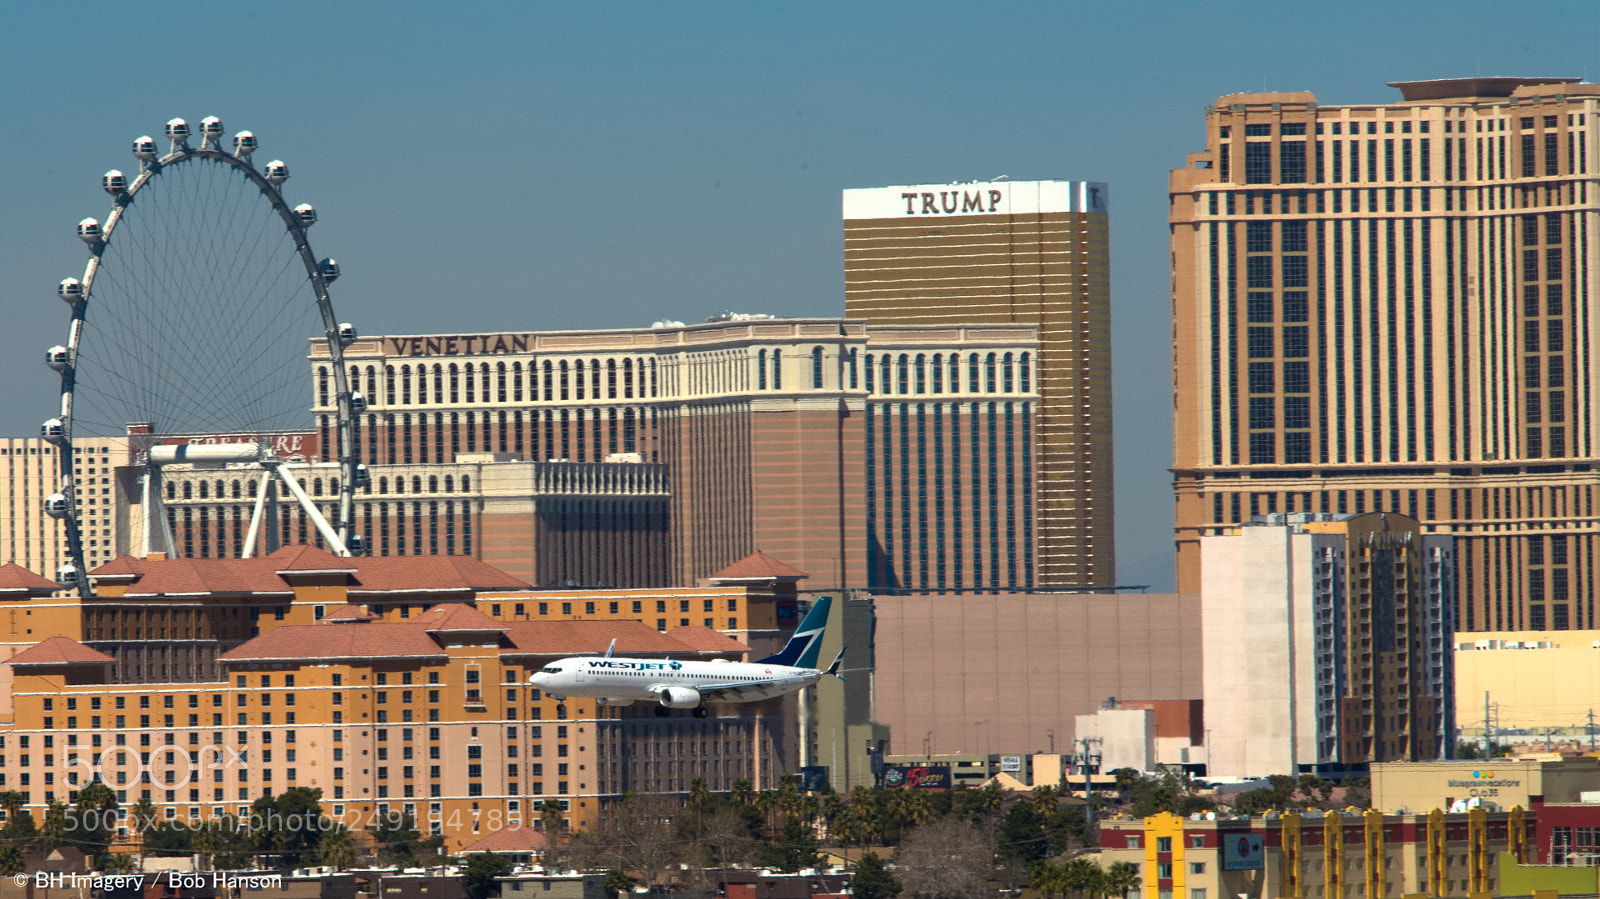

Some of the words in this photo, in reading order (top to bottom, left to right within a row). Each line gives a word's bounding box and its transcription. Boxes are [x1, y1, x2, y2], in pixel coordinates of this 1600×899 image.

[901, 189, 1002, 215] TRUMP
[390, 333, 530, 356] VENETIAN
[187, 435, 303, 454] TRSRE
[588, 660, 668, 671] WESTJET
